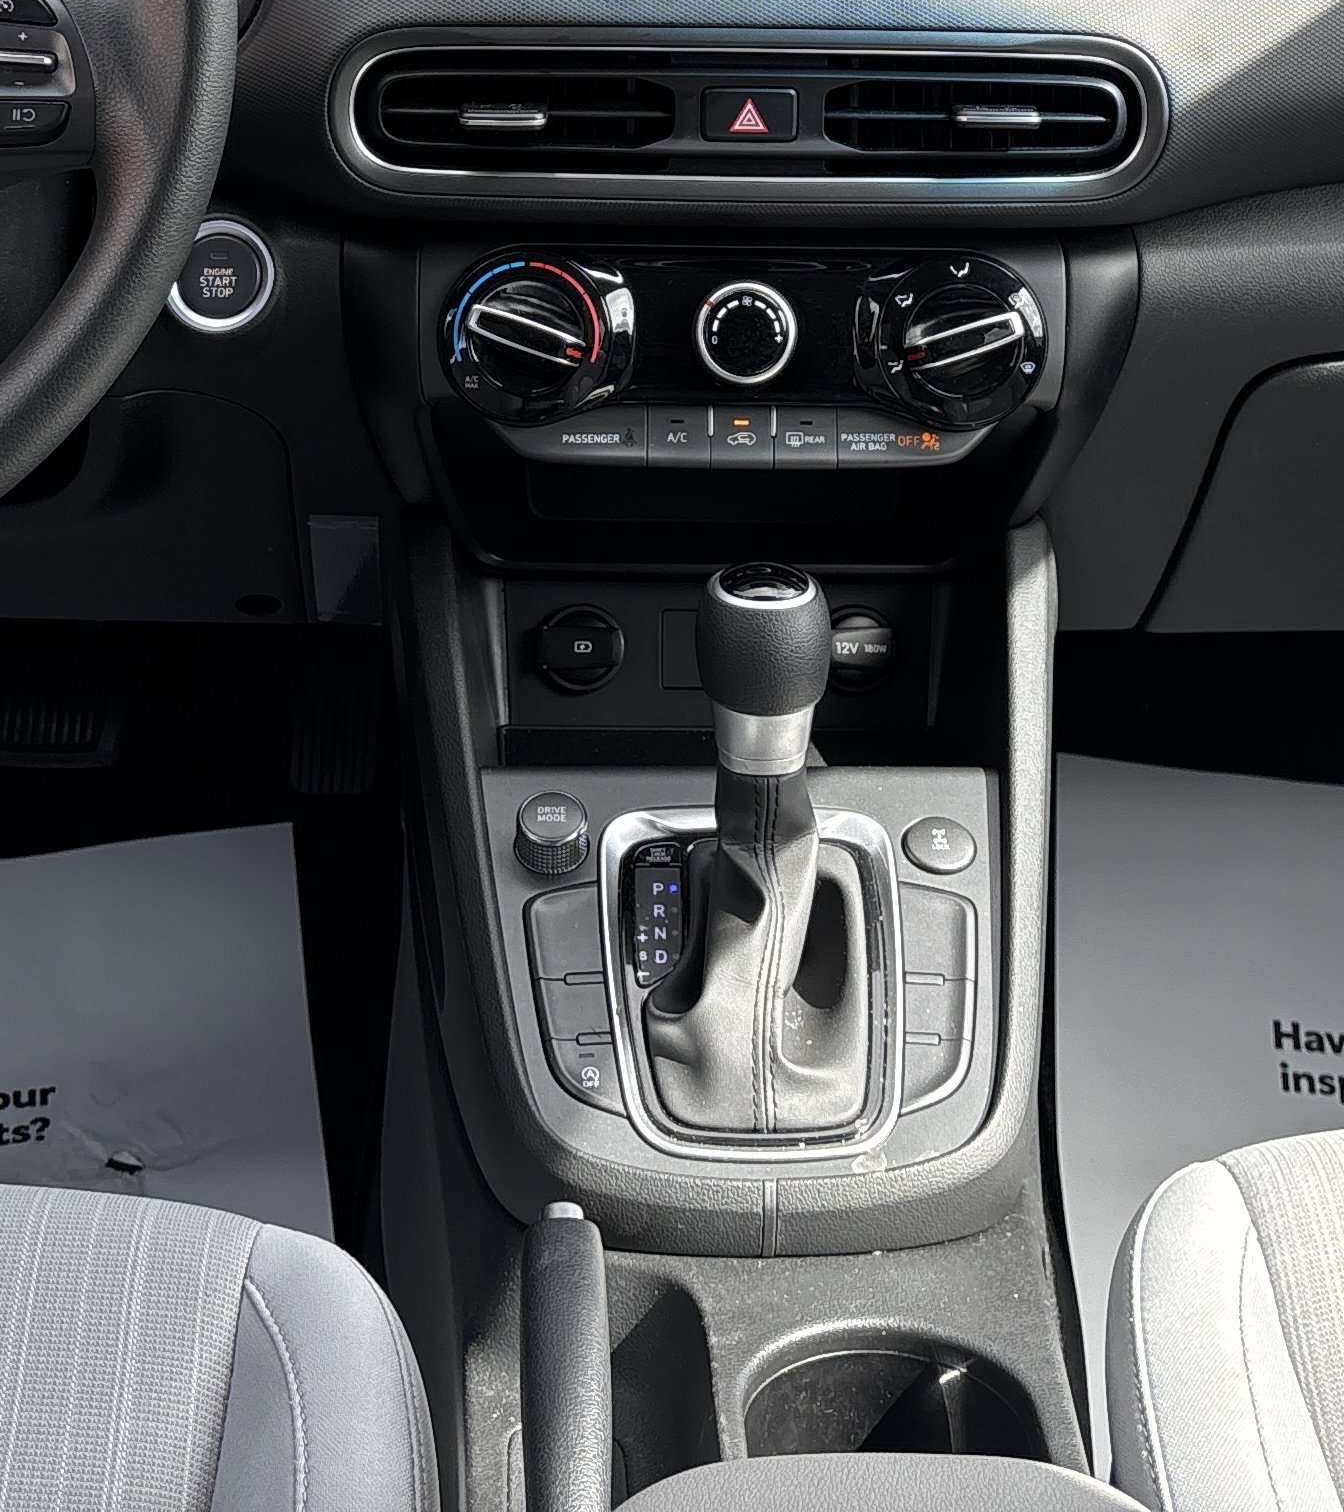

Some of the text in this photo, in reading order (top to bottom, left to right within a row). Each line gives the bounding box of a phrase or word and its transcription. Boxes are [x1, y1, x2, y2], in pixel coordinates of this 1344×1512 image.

[199, 276, 237, 287] START
[202, 287, 234, 298] STOP
[562, 433, 621, 444] PASSENGER
[666, 432, 688, 444] A/C
[805, 435, 825, 444] REAR
[841, 433, 921, 447] PASSENGER OFF
[850, 442, 888, 451] AIR BAG
[836, 641, 859, 655] 12V
[537, 806, 567, 814] DRIVE
[537, 814, 567, 822] MODE
[652, 882, 664, 896] P
[653, 904, 665, 918] R
[654, 926, 667, 940] N
[655, 950, 667, 964] D
